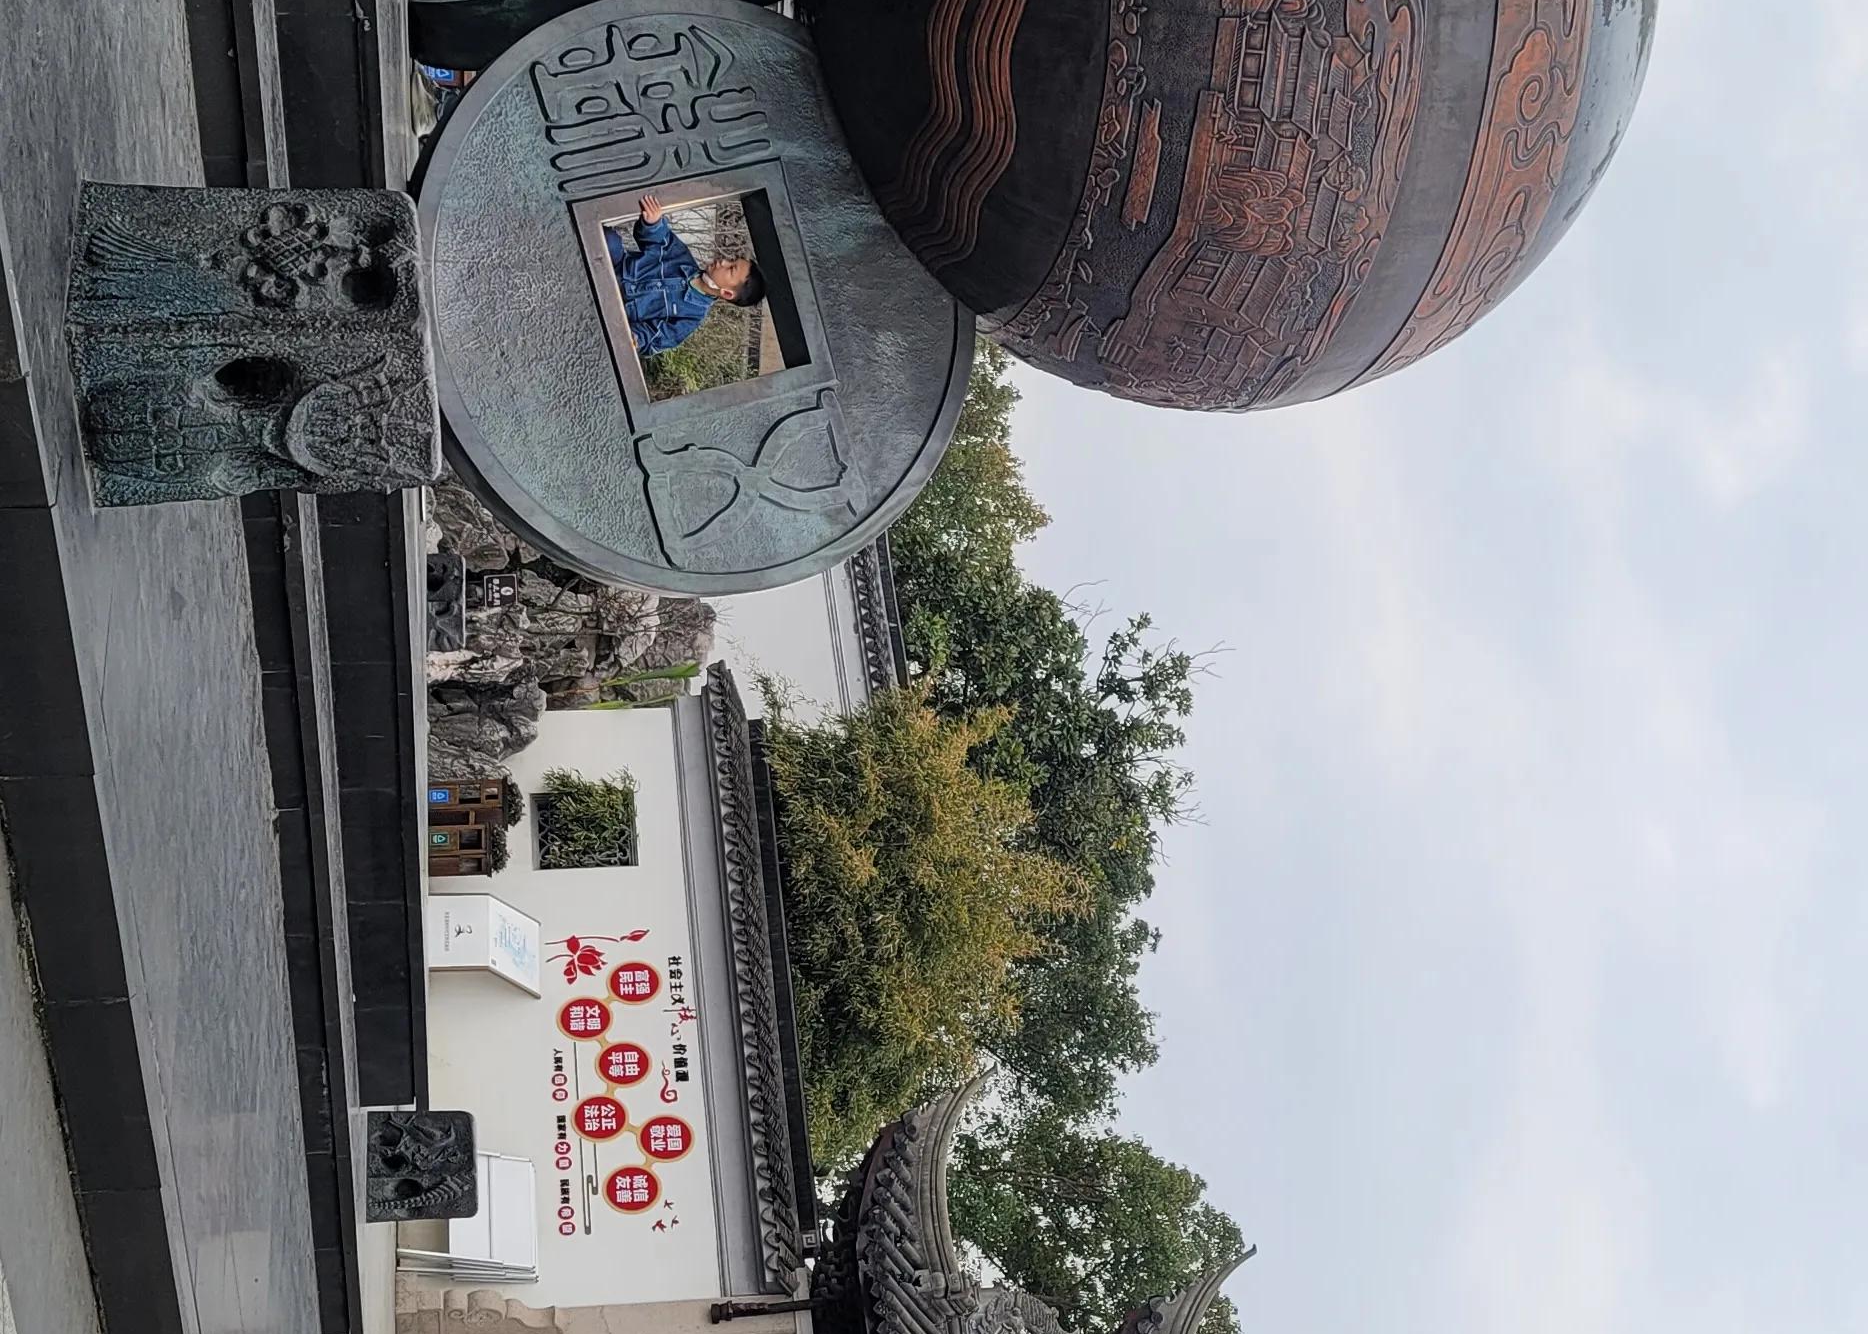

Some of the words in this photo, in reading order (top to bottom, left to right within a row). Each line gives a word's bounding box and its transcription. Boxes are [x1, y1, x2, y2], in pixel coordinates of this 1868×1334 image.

[619, 970, 635, 995] 民主
[635, 970, 650, 995] 富强
[569, 1005, 585, 1031] 和谐
[586, 1005, 601, 1030] 文明
[663, 955, 697, 1083] 社会主义核心价值观
[608, 1051, 623, 1077] 平等
[624, 1051, 639, 1076] 自由
[584, 1105, 600, 1131] 法治
[601, 1104, 616, 1130] 公正
[650, 1125, 666, 1152] 敬业
[667, 1124, 682, 1151] 爱国
[615, 1175, 632, 1203] 友善
[632, 1175, 648, 1203] 诚信
